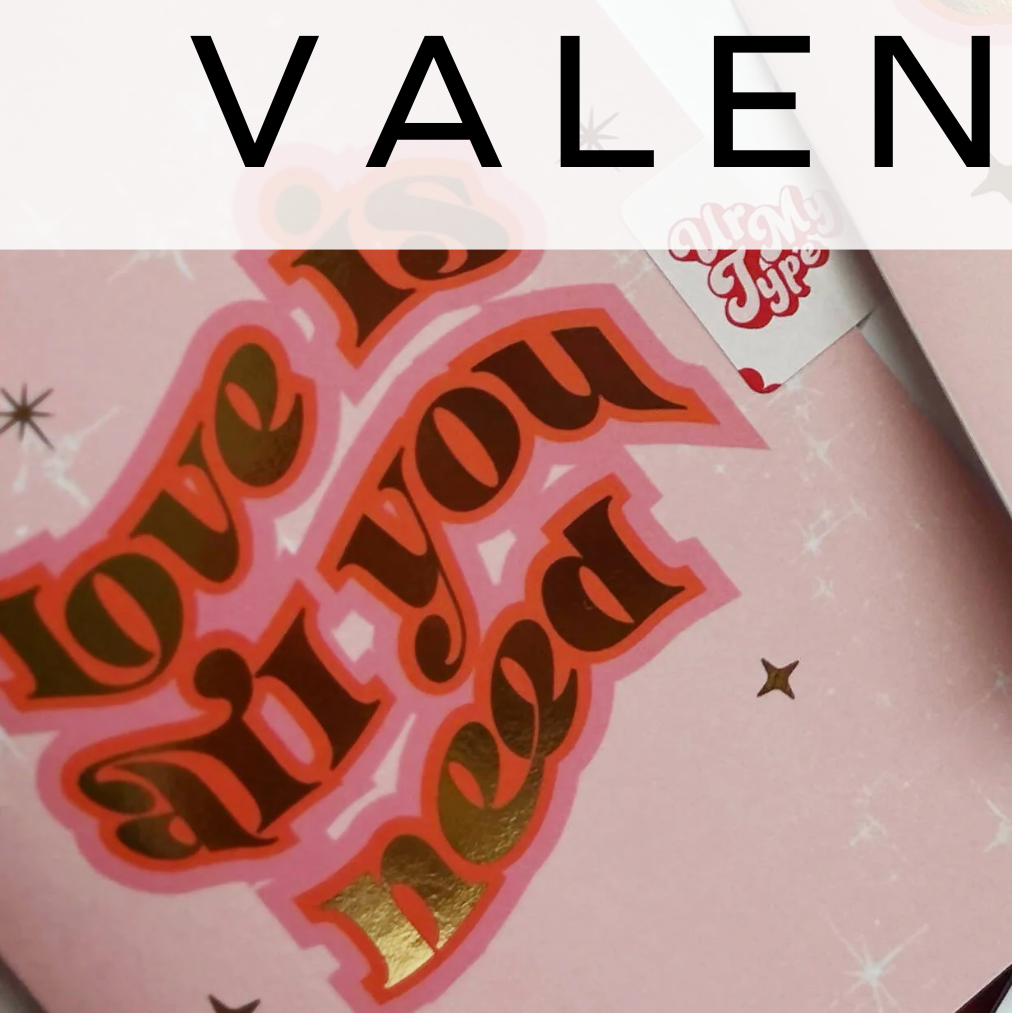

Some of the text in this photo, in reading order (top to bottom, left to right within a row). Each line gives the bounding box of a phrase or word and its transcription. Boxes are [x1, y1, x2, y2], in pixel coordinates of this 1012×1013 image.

[0, 175, 511, 699] love is
[668, 185, 844, 266] Ur My
[707, 240, 830, 329] Type
[78, 326, 688, 860] all you
[322, 496, 685, 989] need
